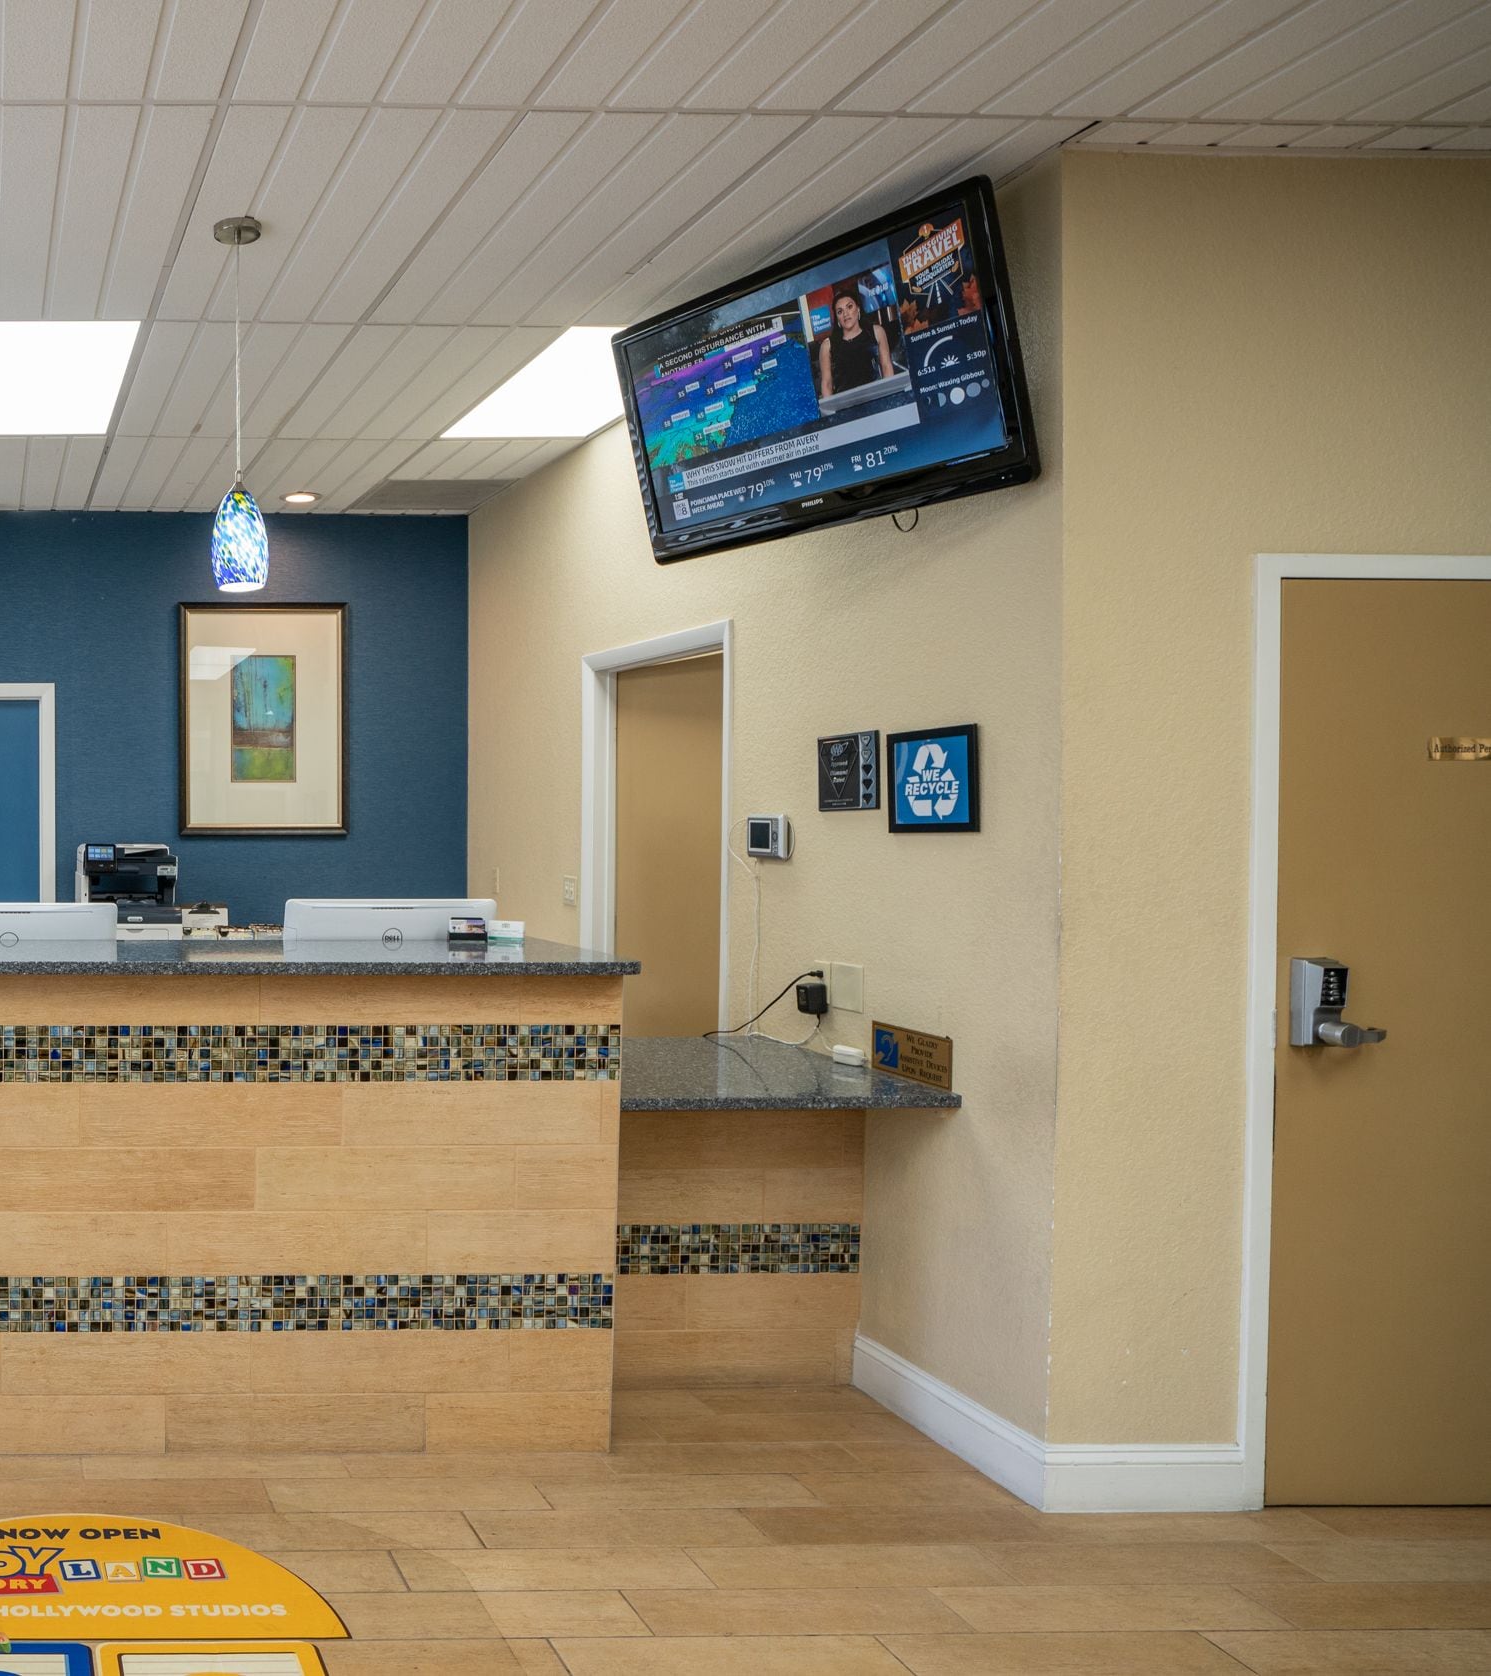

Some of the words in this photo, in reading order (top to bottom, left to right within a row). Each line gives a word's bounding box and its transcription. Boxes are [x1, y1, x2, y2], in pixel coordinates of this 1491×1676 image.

[903, 224, 958, 264] THANKSGIVING
[904, 232, 960, 276] TRAVEL
[915, 269, 930, 280] YOUR
[931, 253, 953, 270] HOLIDAY
[916, 259, 954, 286] HEADQUARTERS
[910, 330, 931, 343] Sunrise
[936, 322, 955, 334] Sunset
[959, 315, 978, 326] Today
[665, 351, 692, 368] SECOND
[694, 332, 744, 356] DISTURBANCE
[746, 323, 766, 335] WITH
[966, 350, 986, 360] 5:30p
[917, 366, 936, 376] 6:51a
[920, 384, 938, 393] Moon:
[938, 377, 960, 388] Waxing
[961, 370, 985, 381] Gibbous
[686, 470, 700, 479] WHY
[702, 464, 714, 474] THIS
[716, 459, 736, 470] SNOW
[736, 456, 747, 464] HIT
[748, 447, 774, 460] DIFFERS
[775, 441, 795, 452] FROM
[796, 433, 819, 447] AVERY
[700, 473, 718, 483] system
[746, 462, 759, 470] with
[761, 455, 785, 466] warmer
[802, 444, 819, 455] place
[851, 455, 861, 463] FRI
[865, 450, 885, 468] 81
[883, 444, 898, 455] 20%
[790, 471, 801, 480] THU
[804, 467, 822, 483] 79
[822, 462, 833, 472] 10%
[691, 494, 717, 507] POINCIANA
[718, 490, 733, 500] PLACE
[733, 486, 746, 495] WED
[748, 483, 763, 499] 79
[692, 505, 707, 514] WEEK
[802, 498, 824, 508] PHILIPS
[1434, 744, 1476, 753] Authorized
[922, 769, 941, 781] WE
[905, 780, 960, 796] RECYCLE
[79, 1528, 161, 1540] OPEN
[68, 1559, 220, 1578] LAND
[170, 1604, 288, 1617] STUDIOS
